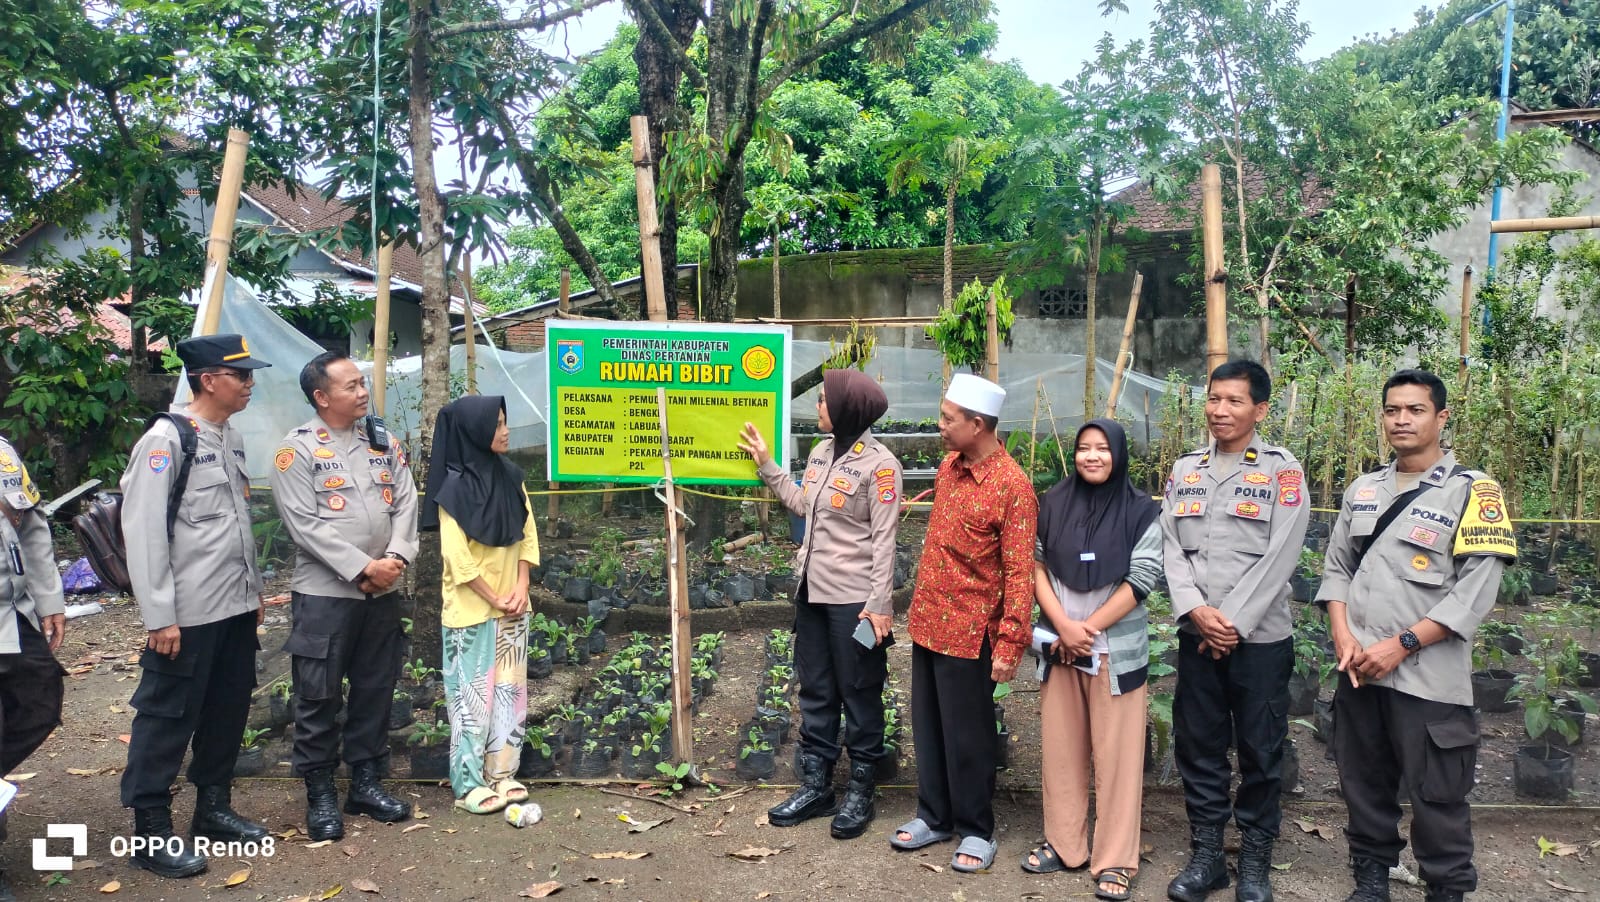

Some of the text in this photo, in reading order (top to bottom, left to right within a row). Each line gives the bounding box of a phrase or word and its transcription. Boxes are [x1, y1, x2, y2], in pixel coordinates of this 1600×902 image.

[603, 338, 729, 352] PEMERINTAH KABUPATEN
[621, 350, 710, 362] DINAS PERTANIAN
[600, 361, 733, 384] RUMAH BIBIT
[564, 393, 613, 403] PELAKSANA
[629, 395, 658, 404] PEMUD
[668, 396, 687, 405] TANI
[690, 397, 729, 406] MILENIAL
[733, 398, 768, 407] BETIKAR
[564, 407, 586, 415] DESA
[629, 408, 660, 418] BENGK
[564, 420, 615, 430] KECAMATAN
[629, 422, 661, 431] LABUAP
[564, 434, 613, 443] KABUPATEN
[668, 436, 694, 445] BARAT
[564, 447, 604, 456] KEGIATAN
[629, 448, 685, 458] PEKARAGAN
[688, 450, 721, 459] PANGAN
[724, 451, 754, 460] LESTA
[315, 462, 344, 471] RUDI
[629, 461, 645, 470] P2L
[810, 458, 827, 467] DEWI
[839, 465, 862, 478] POLRI
[1177, 487, 1207, 496] NURSIDI
[1234, 486, 1272, 500] POLRI
[1410, 507, 1455, 529] POLRI
